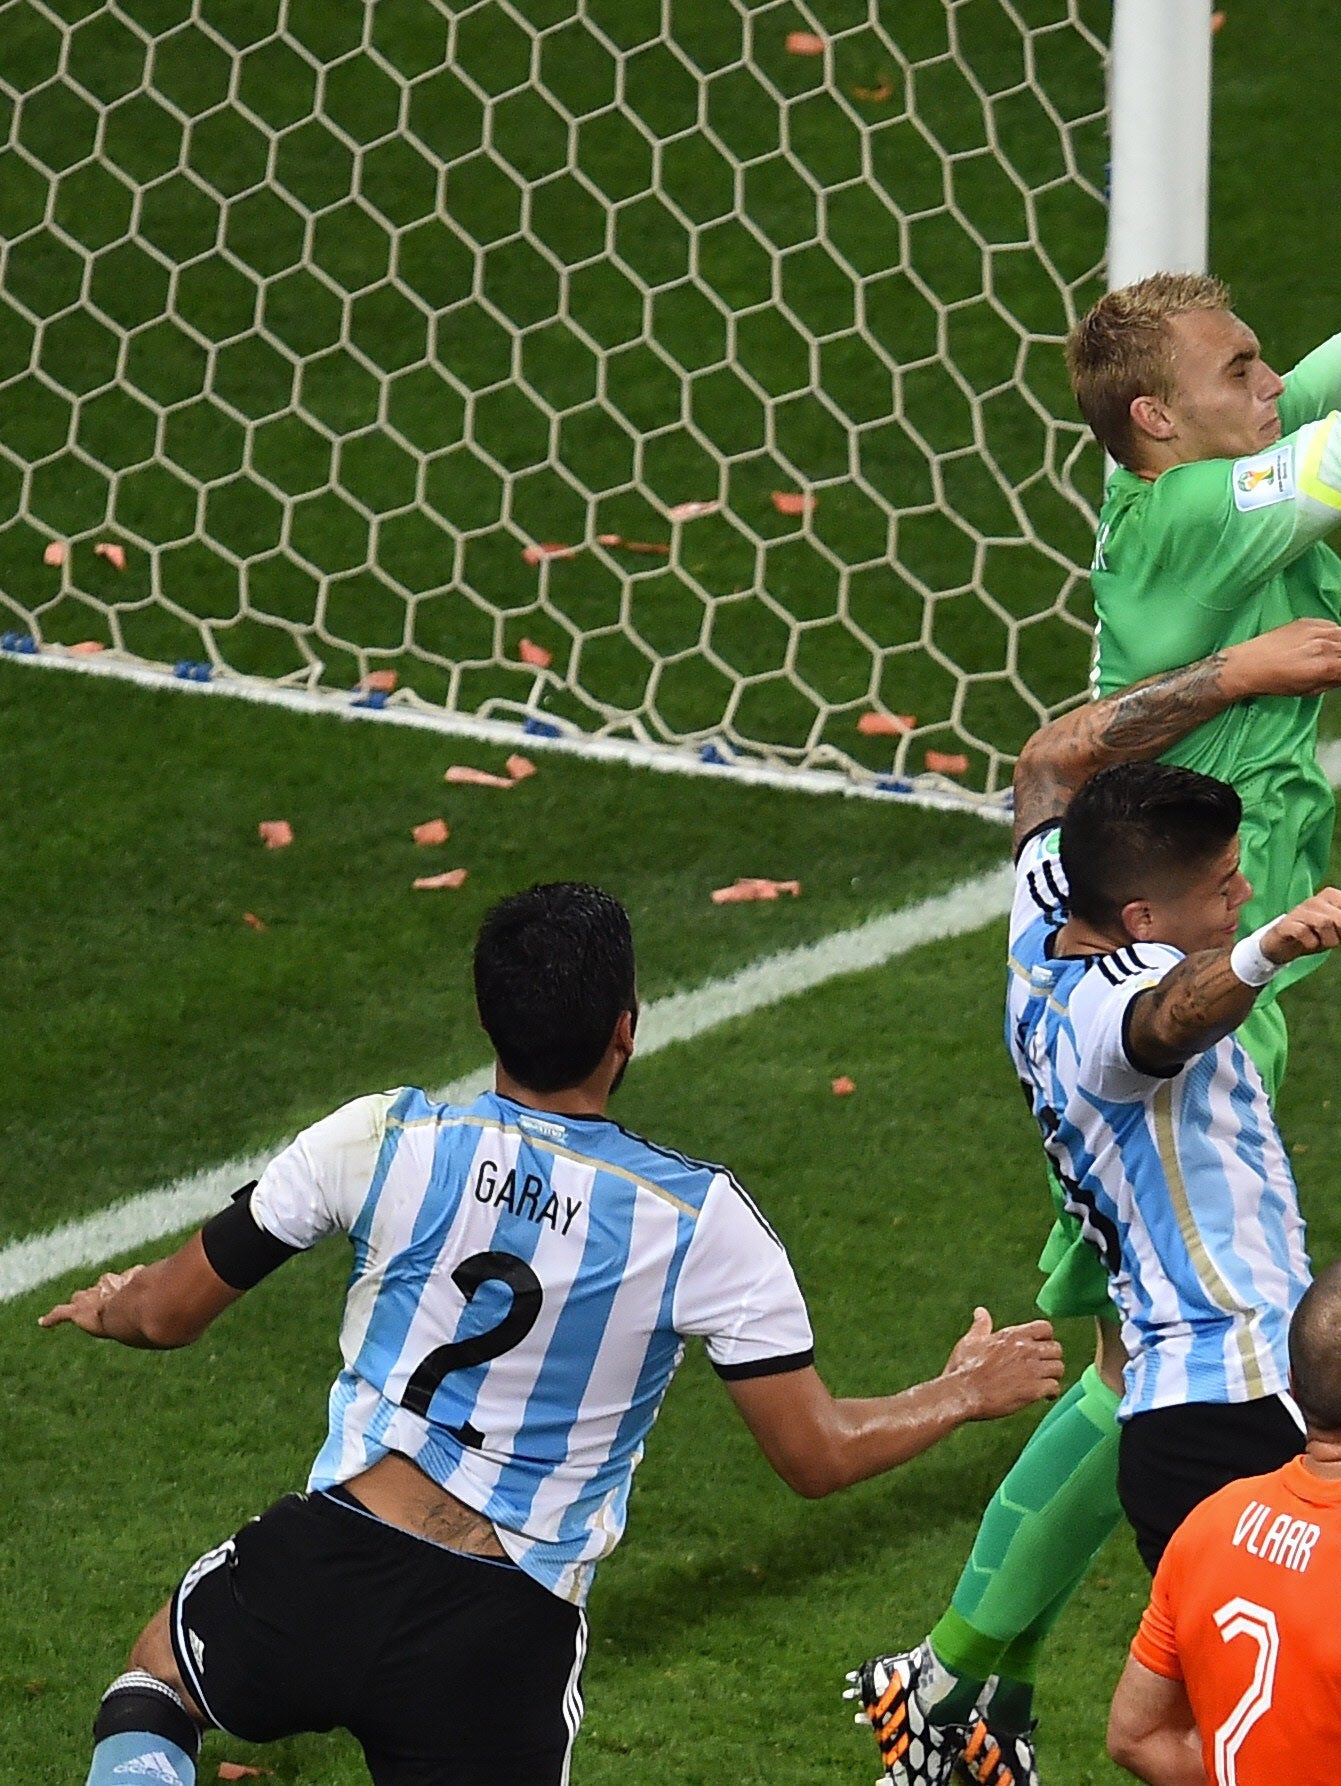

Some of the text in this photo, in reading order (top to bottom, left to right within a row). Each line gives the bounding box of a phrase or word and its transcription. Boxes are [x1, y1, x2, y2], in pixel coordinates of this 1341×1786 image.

[474, 1160, 583, 1236] GARAY
[401, 1250, 544, 1449] 2
[1231, 1500, 1321, 1573] VLAAR
[1212, 1596, 1280, 1786] 2
